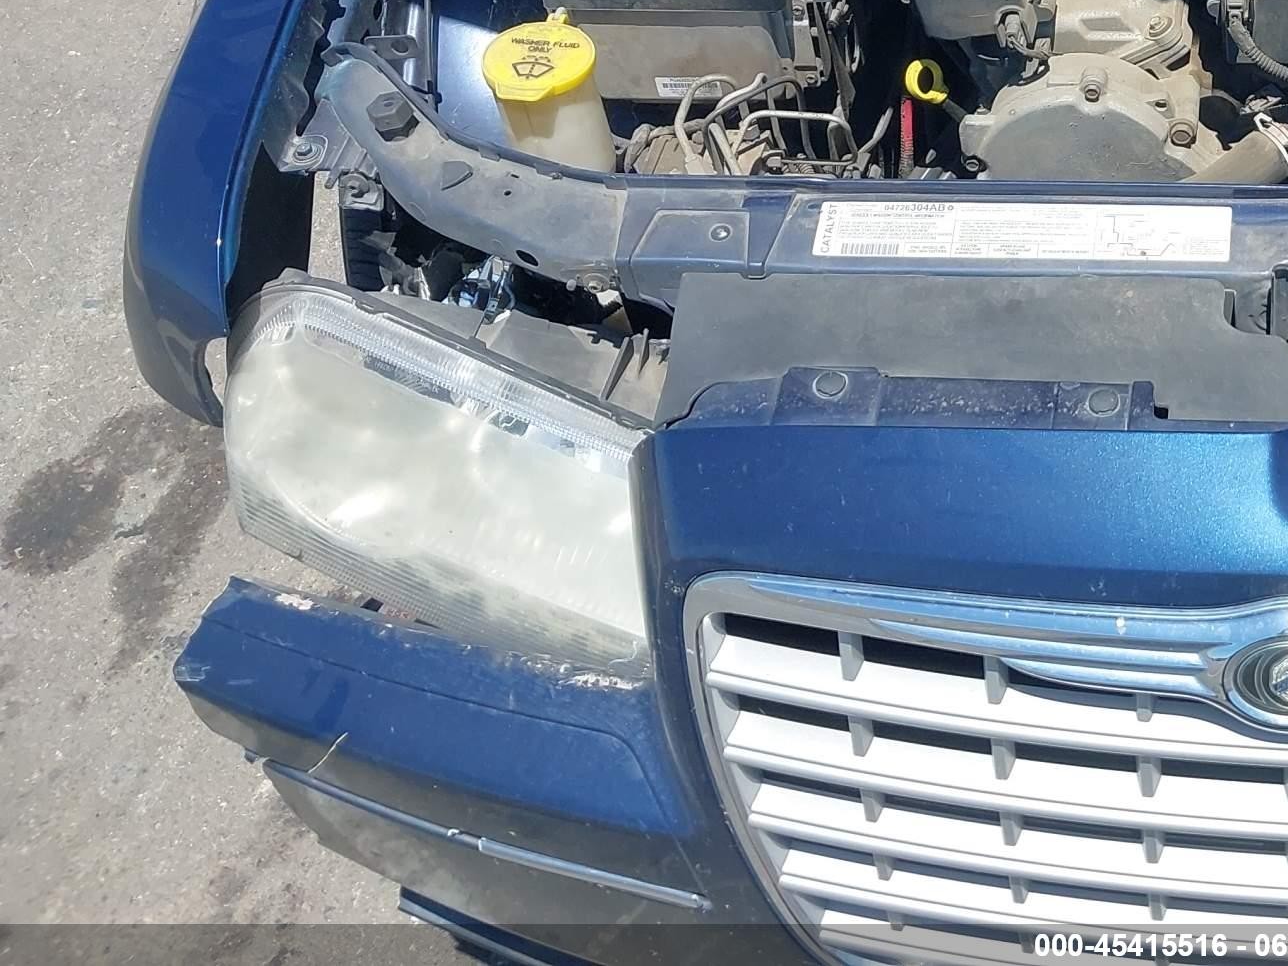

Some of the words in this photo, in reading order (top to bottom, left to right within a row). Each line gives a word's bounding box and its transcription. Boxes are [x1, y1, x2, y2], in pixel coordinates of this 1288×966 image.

[511, 37, 550, 47] WASHER
[553, 40, 580, 49] FLUID
[820, 204, 840, 253] CATALYST
